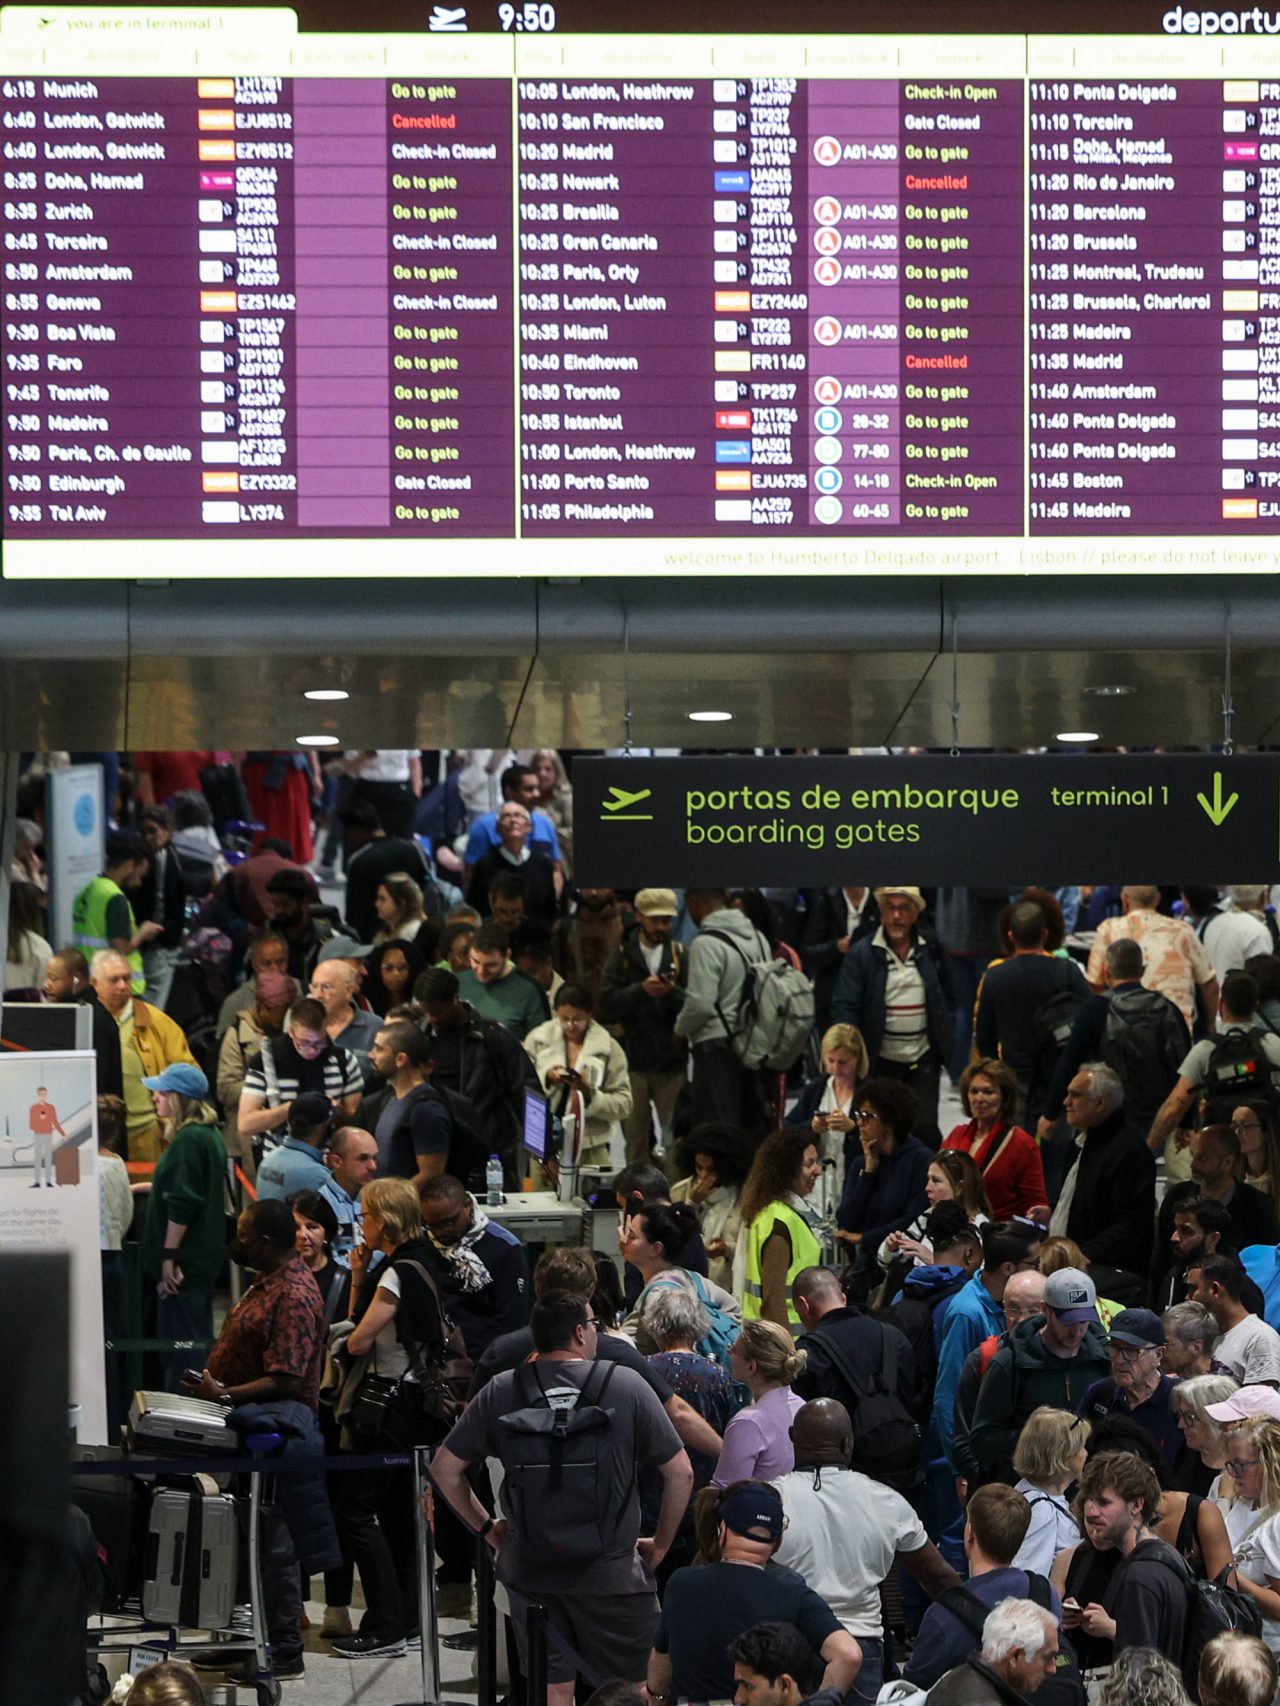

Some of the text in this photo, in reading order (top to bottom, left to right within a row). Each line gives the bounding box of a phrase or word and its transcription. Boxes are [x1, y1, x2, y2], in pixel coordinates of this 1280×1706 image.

[499, 4, 555, 31] 9:50
[562, 83, 620, 101] London,
[623, 83, 694, 100] Heathrow
[905, 85, 997, 102] Check-in Open
[1074, 84, 1115, 100] Ponta
[1118, 84, 1176, 104] Delgada
[44, 112, 103, 130] London,
[106, 112, 164, 129] Gatwick
[393, 114, 456, 128] Cancelled
[562, 113, 664, 130] San Francisco
[392, 144, 496, 159] Check-in Closed
[45, 172, 143, 191] Doha, Hamad
[563, 174, 619, 190] Newark
[1074, 174, 1174, 190] Rio de Janeiro
[45, 203, 93, 219] Zurich
[1074, 204, 1146, 220] Barcelona
[905, 235, 968, 252] Go to gate
[46, 264, 132, 280] Amsterdam
[393, 265, 457, 283] Go to gate
[1073, 264, 1204, 281] Montreal, Trudeau
[1073, 294, 1210, 311] Brussels, Charleroi
[564, 354, 638, 370] Eindhoven
[906, 355, 967, 368] Cancelled
[1073, 354, 1123, 369] Madrid
[563, 384, 620, 400] Toronto
[48, 415, 108, 431] Madeira
[564, 414, 623, 430] Istanbul
[49, 475, 125, 495] Edinburgh
[395, 475, 471, 489] Gate Closed
[565, 474, 649, 489] Porto Santo
[1073, 473, 1123, 488] Boston
[49, 505, 106, 521] Tel Aviv
[565, 504, 653, 522] Philadelphia
[664, 552, 742, 565] welcome
[748, 551, 764, 564] to
[771, 550, 858, 564] Humberto
[865, 550, 935, 569] Delgado
[941, 550, 998, 567] airport
[1019, 550, 1075, 563] Lisbon
[1101, 550, 1157, 567] please
[1166, 549, 1183, 562] do
[1190, 550, 1216, 562] not
[1223, 549, 1266, 562] leave
[687, 784, 1019, 816] portas de embarque
[1051, 786, 1167, 805] terminal 1
[688, 819, 920, 849] boarding gates
